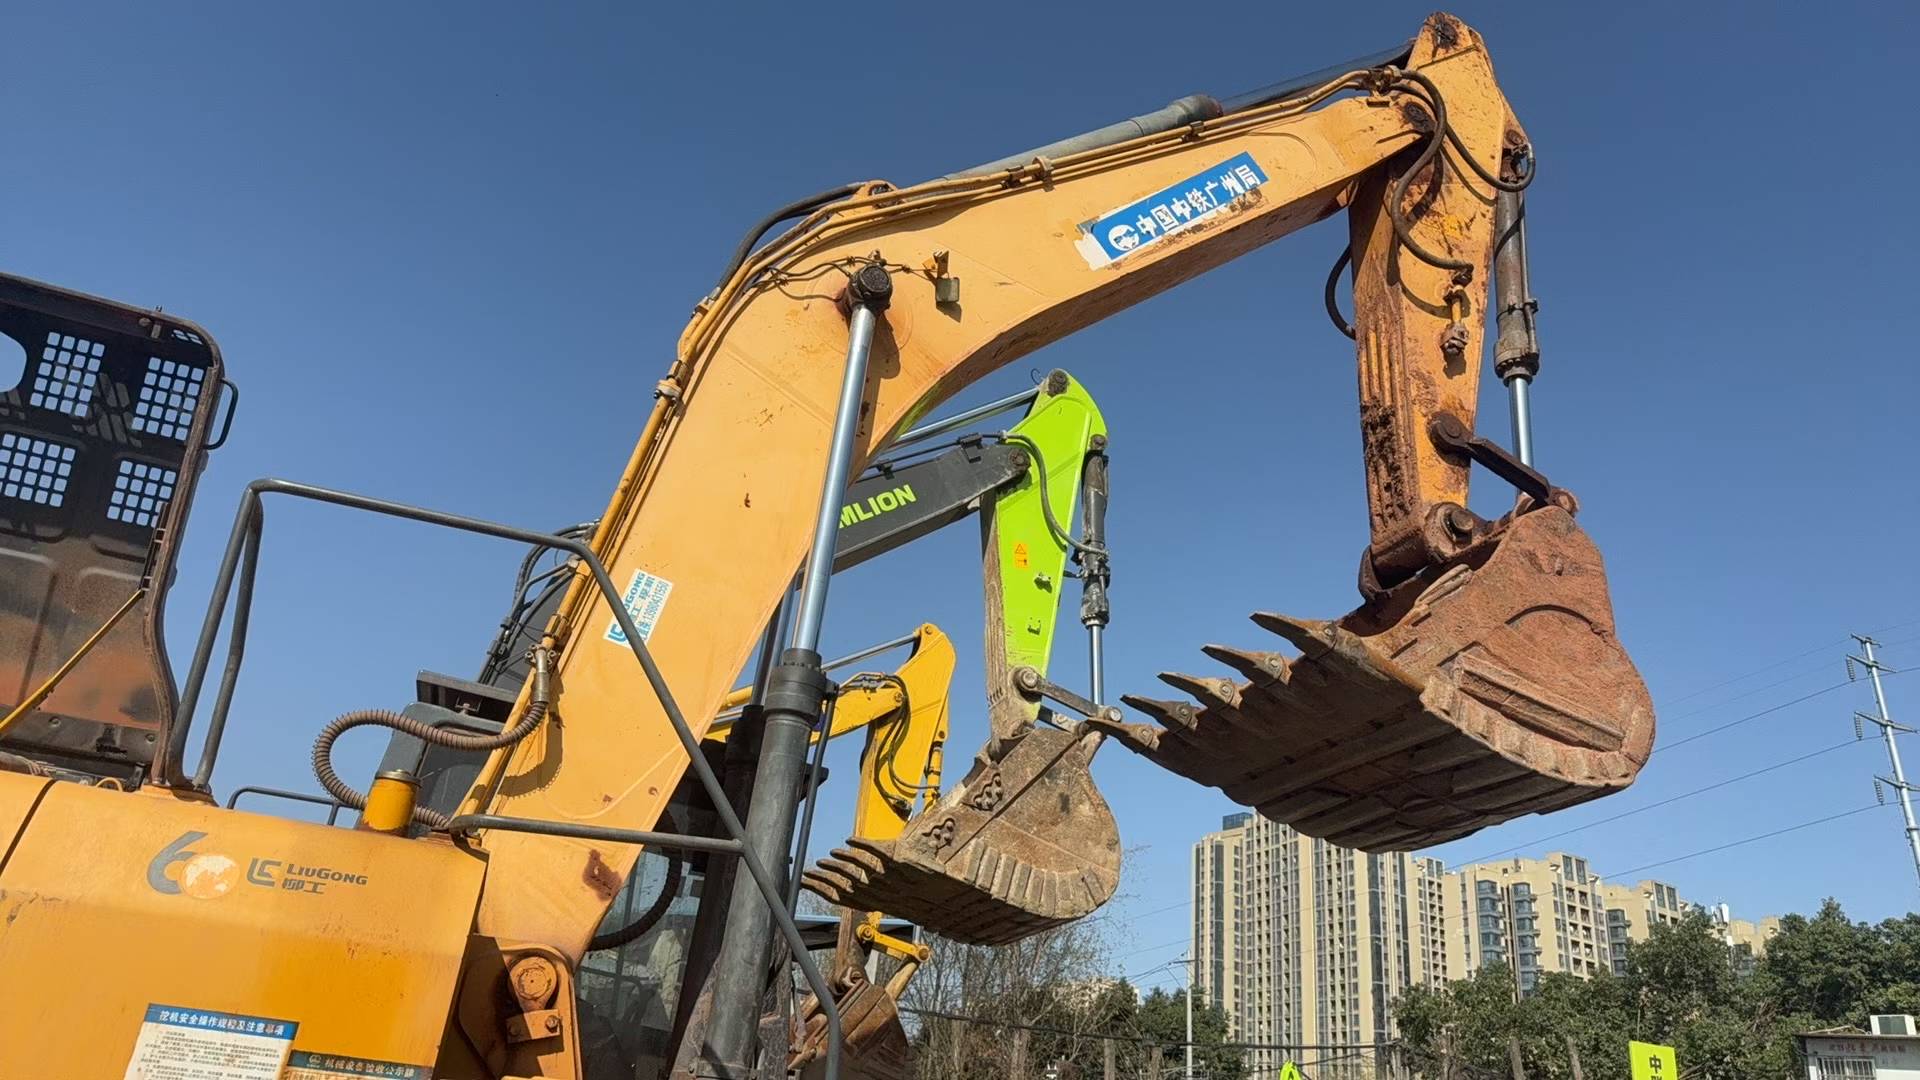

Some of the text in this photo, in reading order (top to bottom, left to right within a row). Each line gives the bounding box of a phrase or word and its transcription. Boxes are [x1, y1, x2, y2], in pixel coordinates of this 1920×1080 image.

[1135, 164, 1261, 238] 中国中铁广州局
[282, 878, 327, 895] 柳工
[286, 862, 368, 886] LIUGONG
[1648, 1053, 1663, 1080] 中
